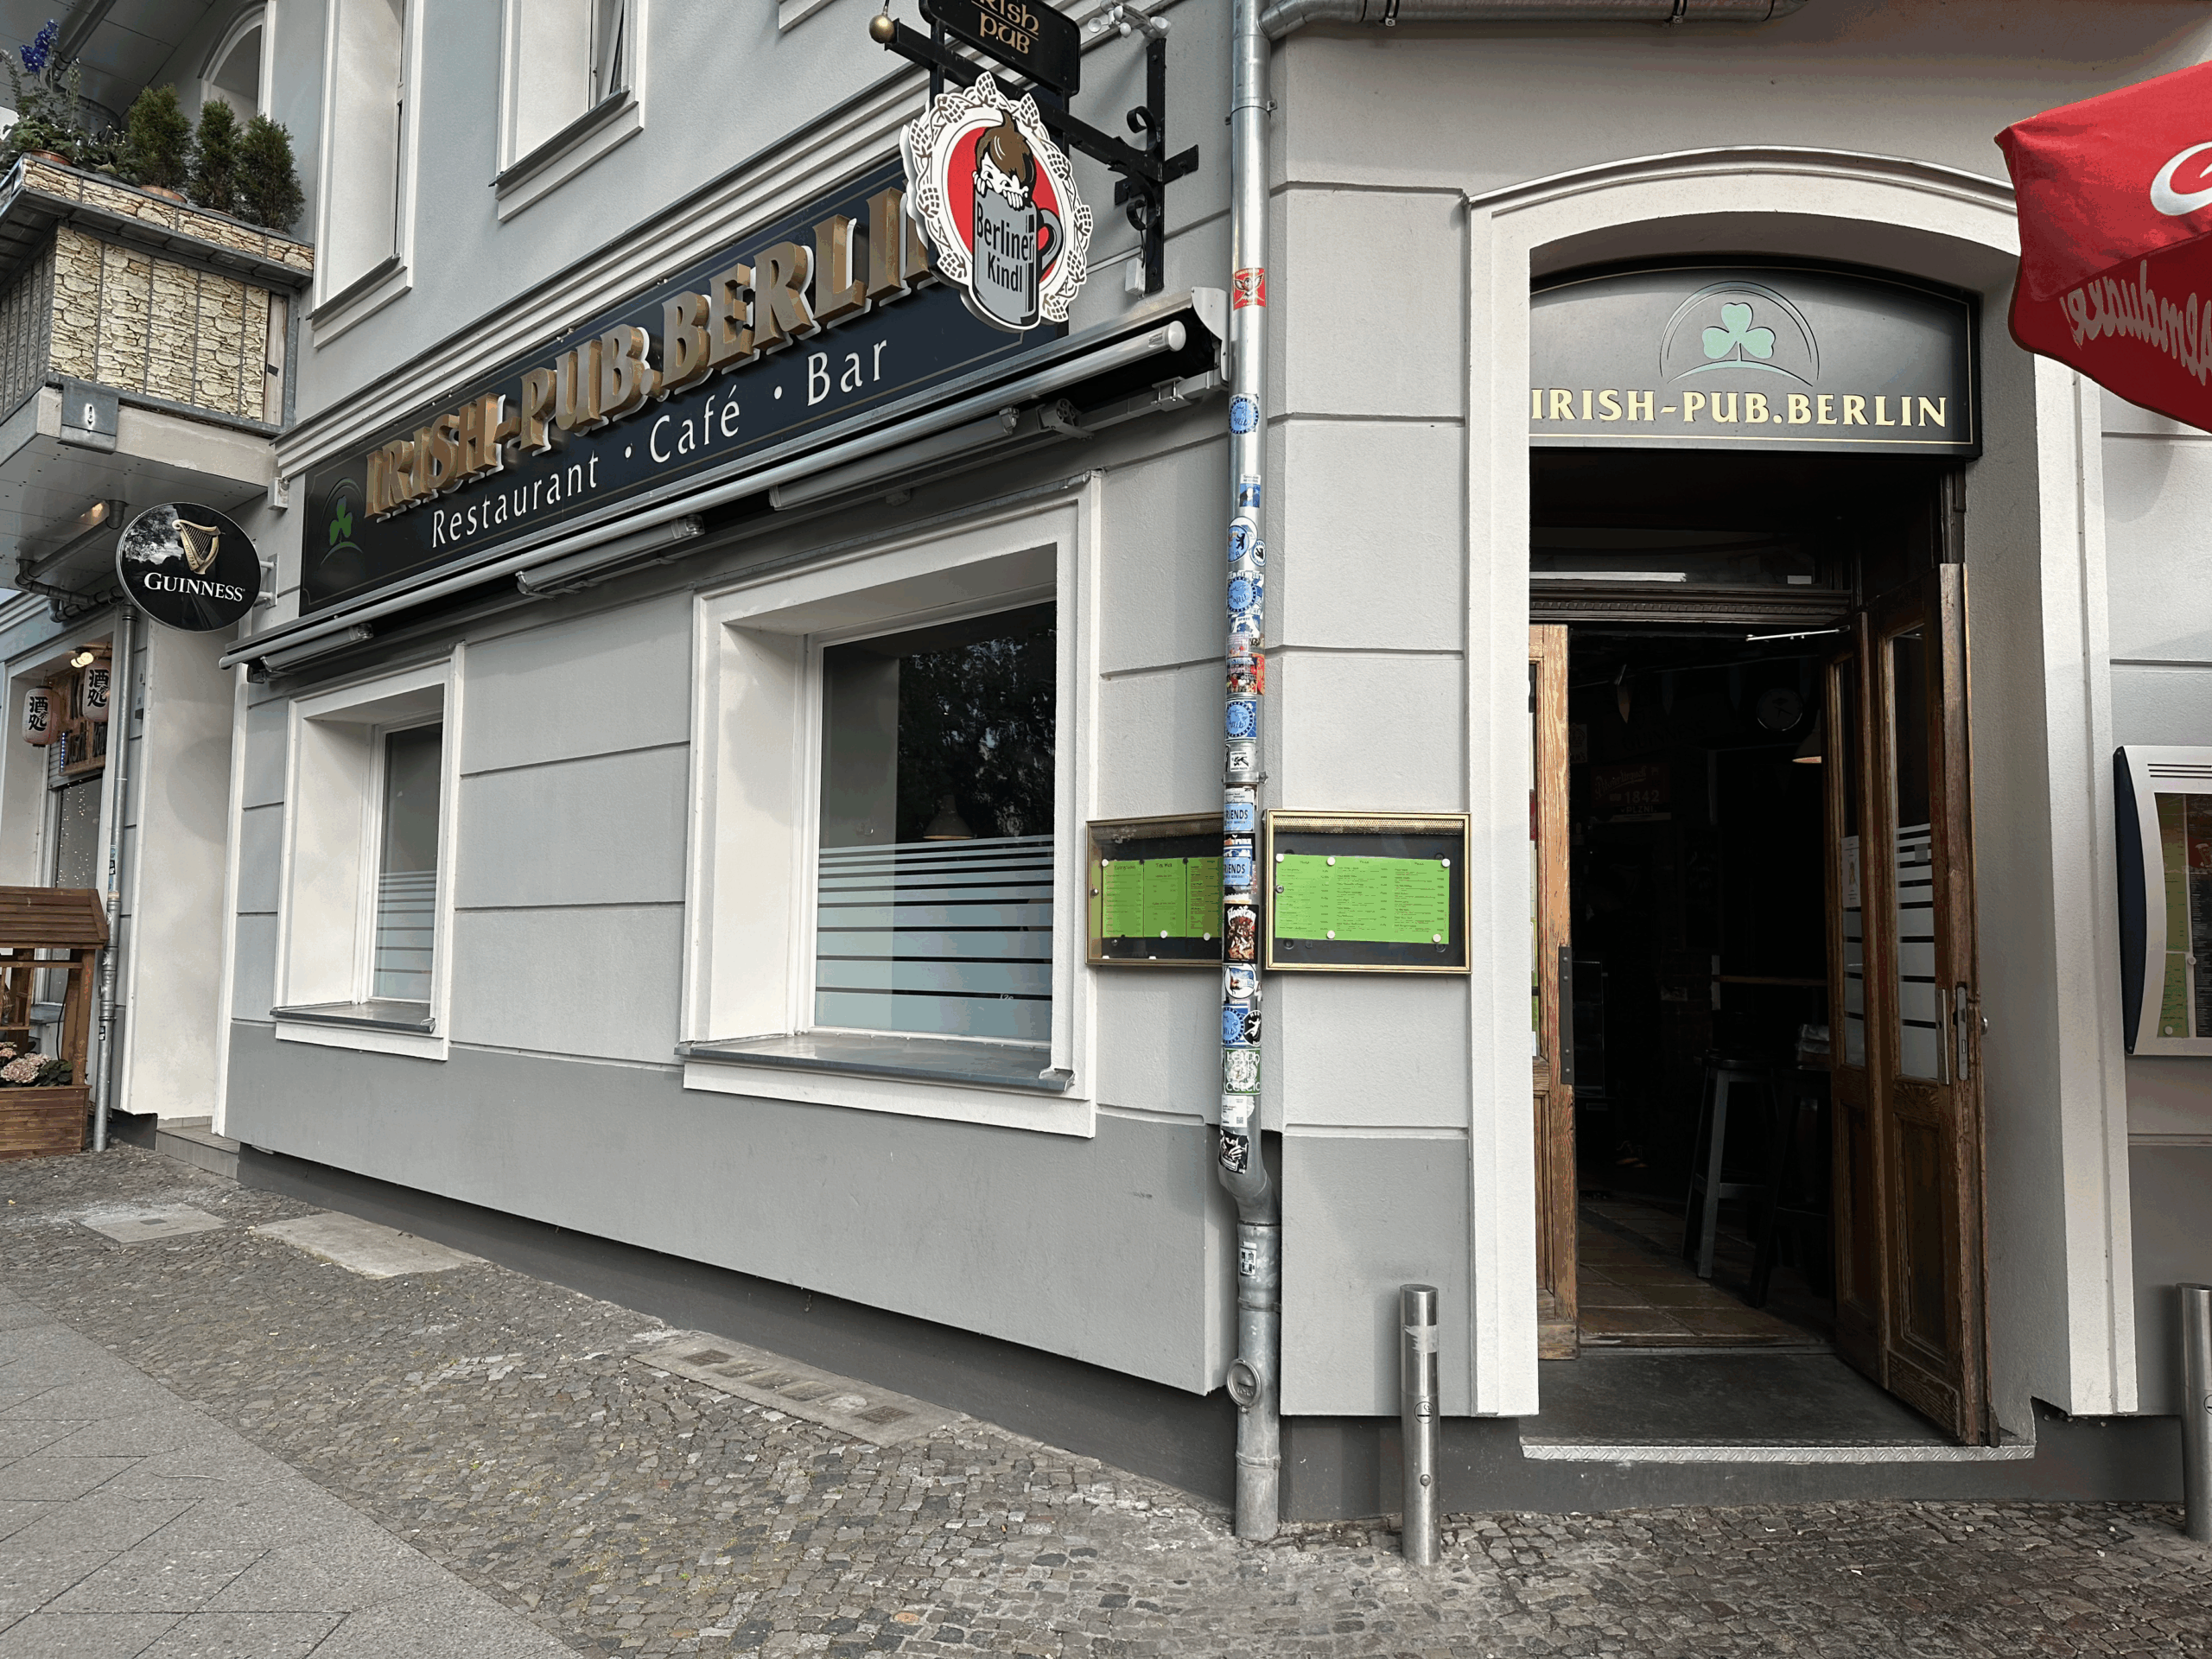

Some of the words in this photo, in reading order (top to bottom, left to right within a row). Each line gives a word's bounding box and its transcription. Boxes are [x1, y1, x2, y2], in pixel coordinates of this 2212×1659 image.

[977, 200, 1033, 261] Berliner
[988, 251, 1022, 293] Kindl
[1531, 389, 1948, 429] IRISH-PUB.BERLIN
[433, 449, 599, 548] Restaurant
[648, 385, 741, 464] Café
[807, 340, 888, 406] Bar
[143, 572, 243, 602] GUINNESS
[1624, 789, 1660, 804] 1842
